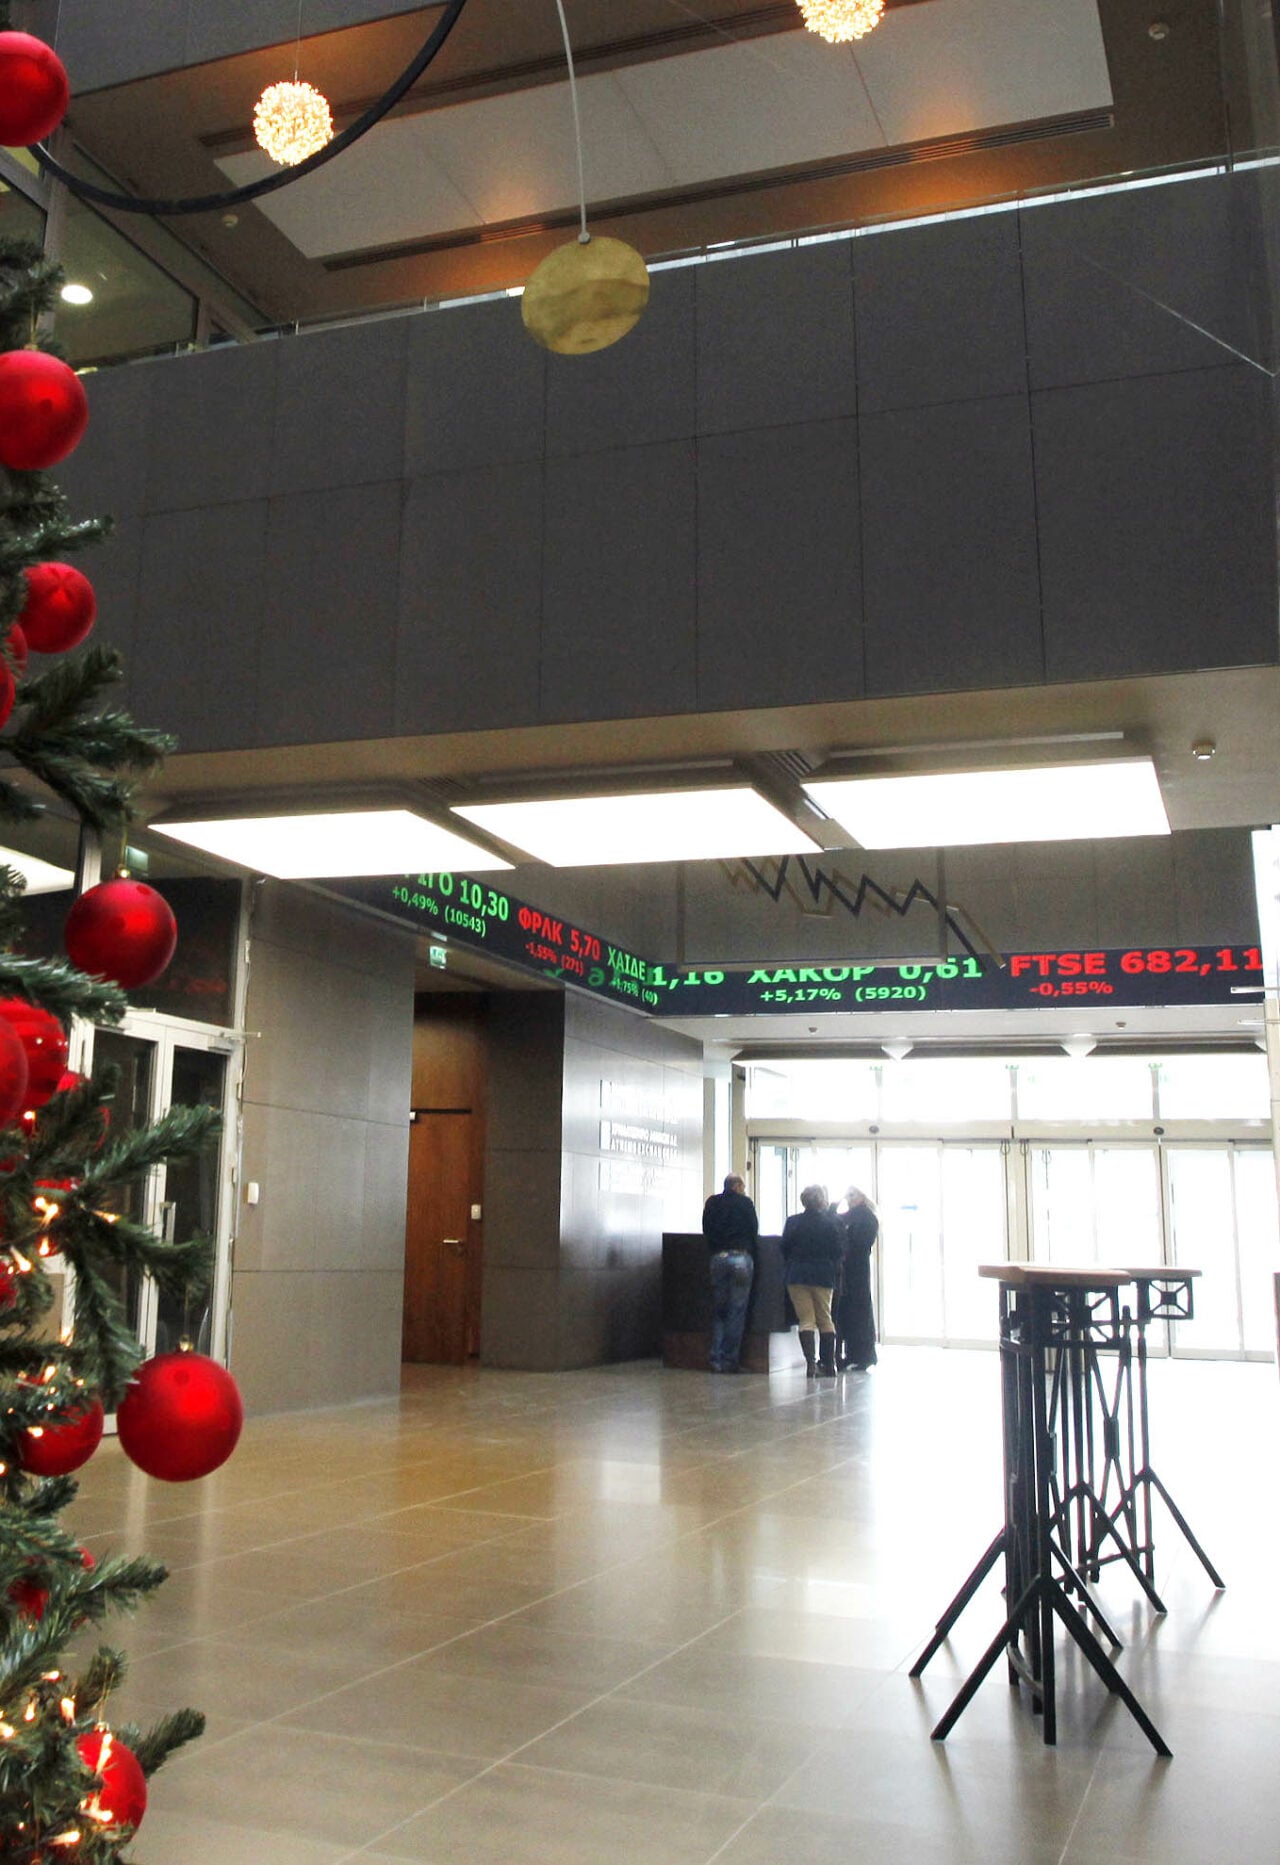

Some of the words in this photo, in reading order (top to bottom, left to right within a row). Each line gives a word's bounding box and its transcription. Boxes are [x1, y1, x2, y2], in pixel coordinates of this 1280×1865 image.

[393, 886, 439, 916] +0,49%
[445, 905, 487, 938] (10543)
[460, 880, 510, 921] 10,30
[570, 928, 601, 961] 5,70
[898, 957, 982, 983] 0,61
[1010, 953, 1106, 977] FTSE
[1121, 948, 1263, 976] 682,11
[761, 988, 841, 1003] +5,17%
[855, 987, 926, 1002] (5920)
[1029, 981, 1113, 997] -0,55%
